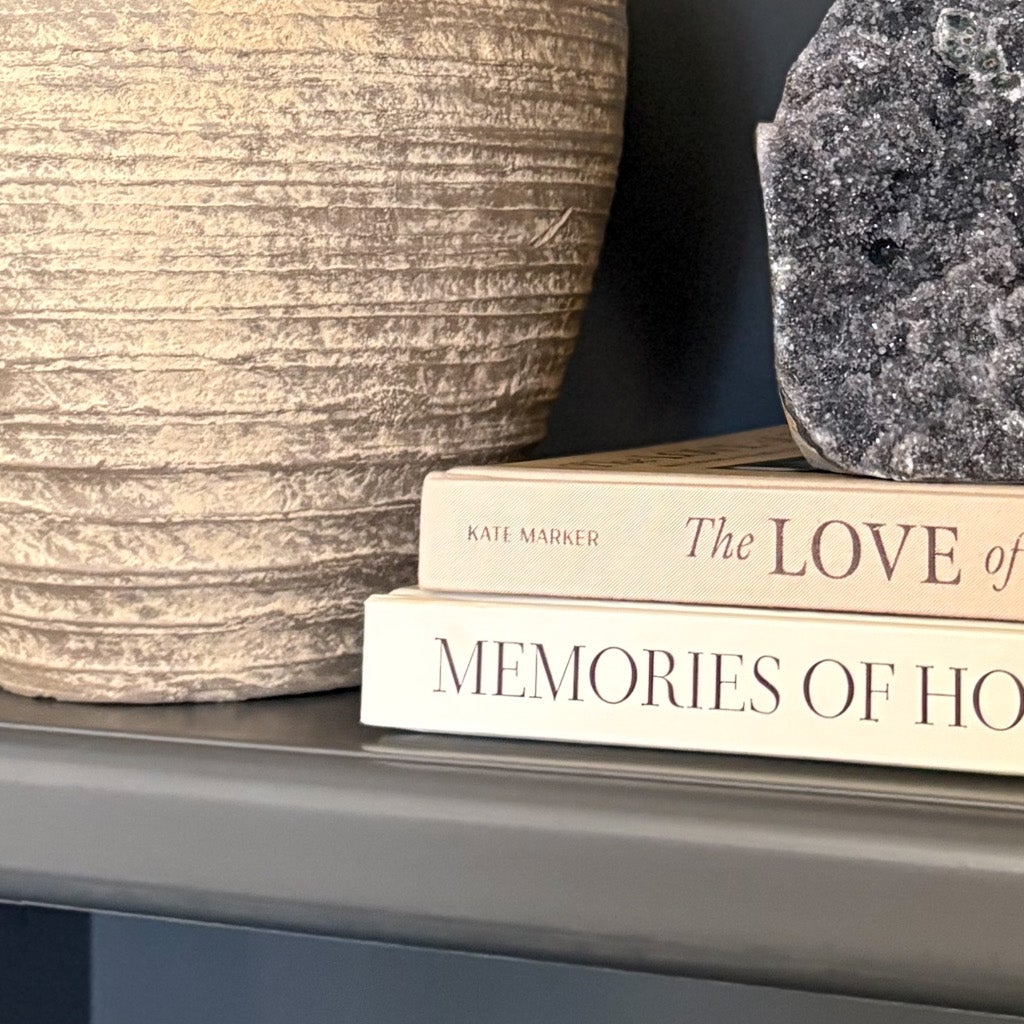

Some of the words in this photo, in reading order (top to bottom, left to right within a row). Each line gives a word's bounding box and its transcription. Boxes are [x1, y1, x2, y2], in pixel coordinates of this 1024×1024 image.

[466, 524, 512, 544] KATE
[519, 526, 600, 548] MARKER
[685, 515, 756, 562] The
[767, 518, 962, 585] LOVE
[433, 637, 781, 715] MEMORIES
[802, 659, 895, 723] OF
